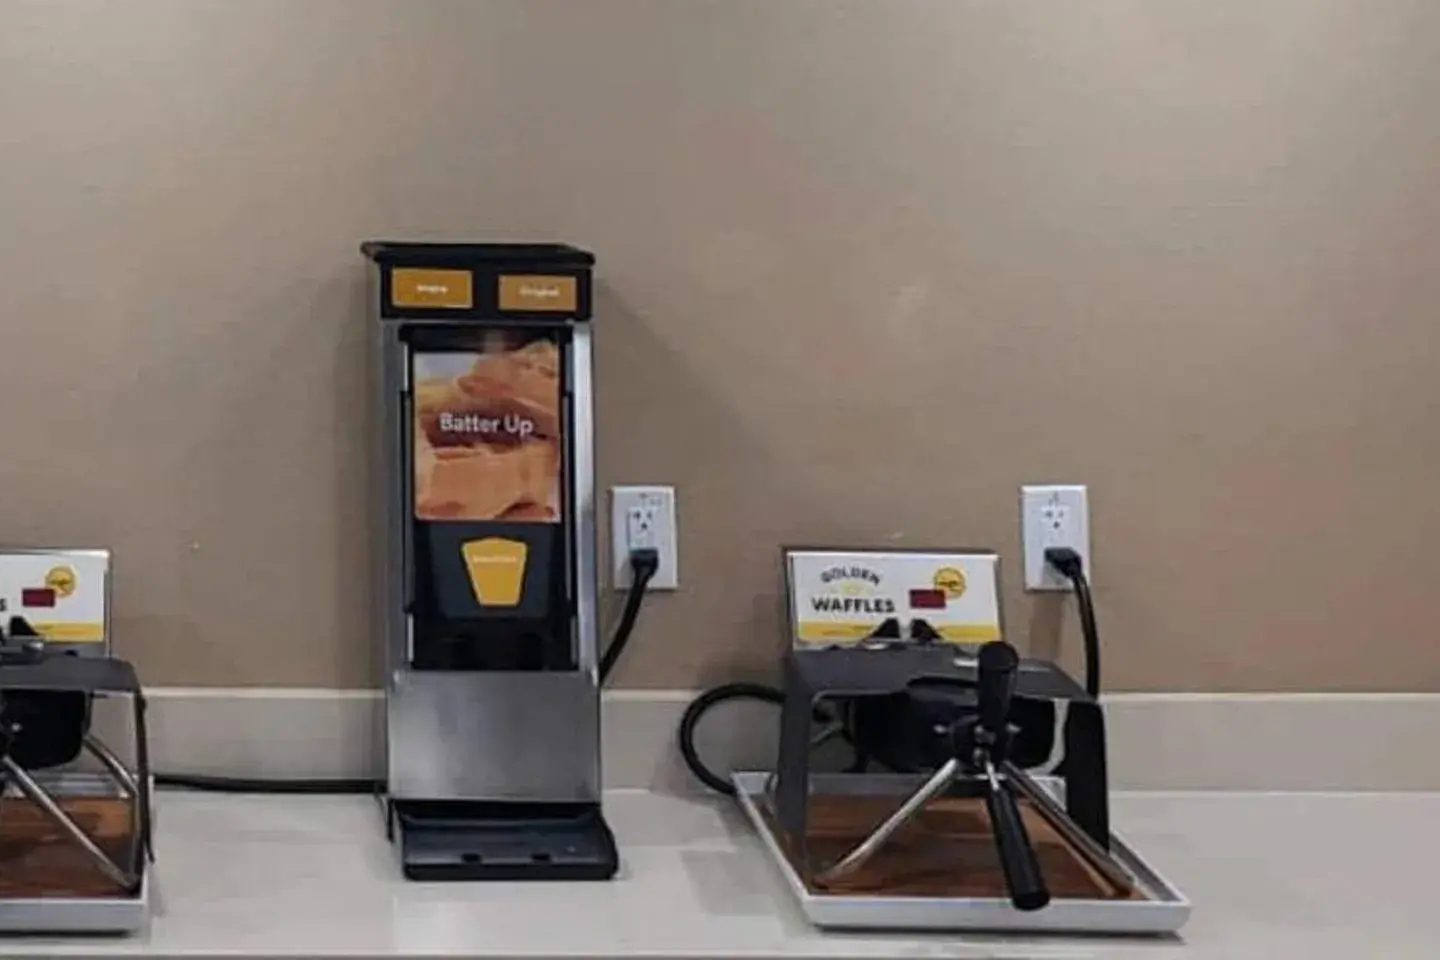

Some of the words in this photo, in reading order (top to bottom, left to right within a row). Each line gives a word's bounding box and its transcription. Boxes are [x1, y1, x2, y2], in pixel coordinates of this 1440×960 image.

[439, 413, 501, 433] Batter
[504, 414, 535, 437] Up
[821, 567, 880, 585] GOLDEN
[812, 597, 895, 613] WAFFLES
